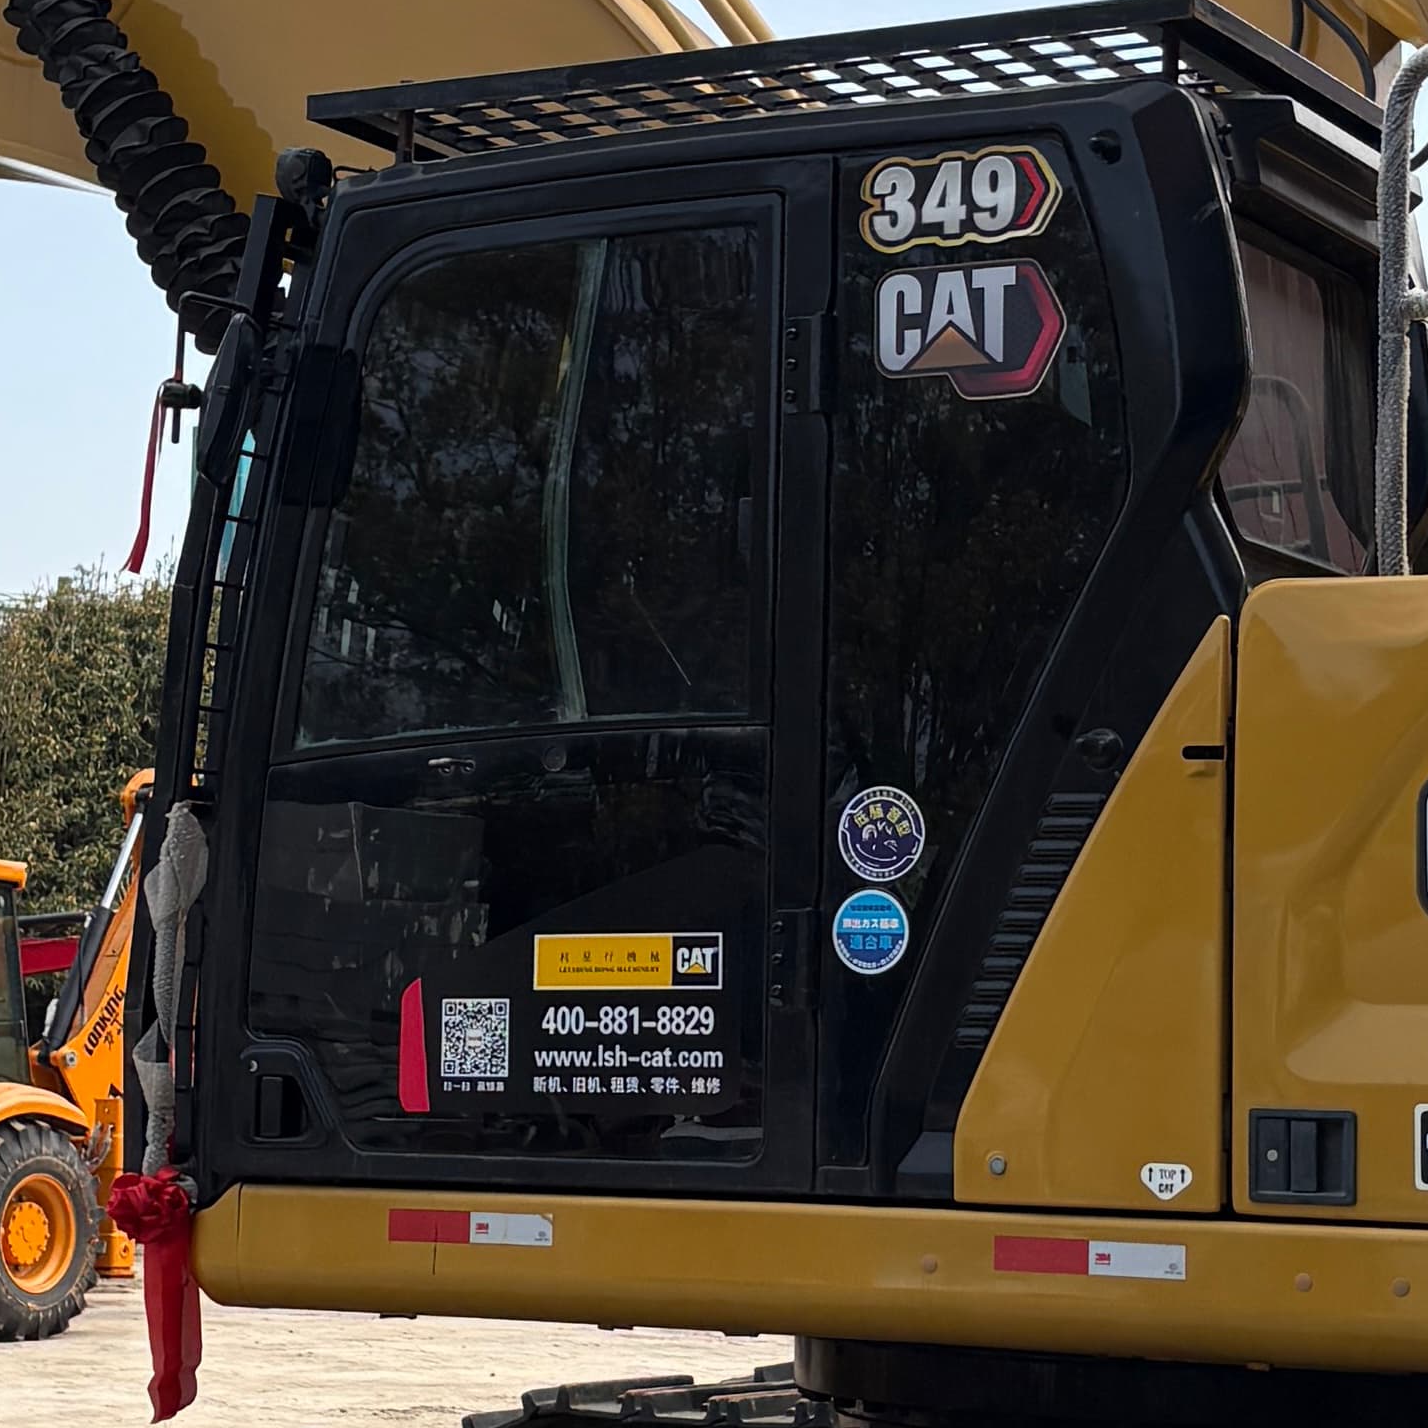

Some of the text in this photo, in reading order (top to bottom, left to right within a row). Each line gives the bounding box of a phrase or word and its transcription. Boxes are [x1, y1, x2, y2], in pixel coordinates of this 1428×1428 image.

[872, 155, 1017, 242] 349
[879, 265, 1017, 372] CAT
[676, 947, 715, 974] CAT
[541, 1005, 715, 1036] 400-881-8829
[533, 1045, 724, 1068] www.lsh-cat.com
[1158, 1169, 1177, 1180] TOP
